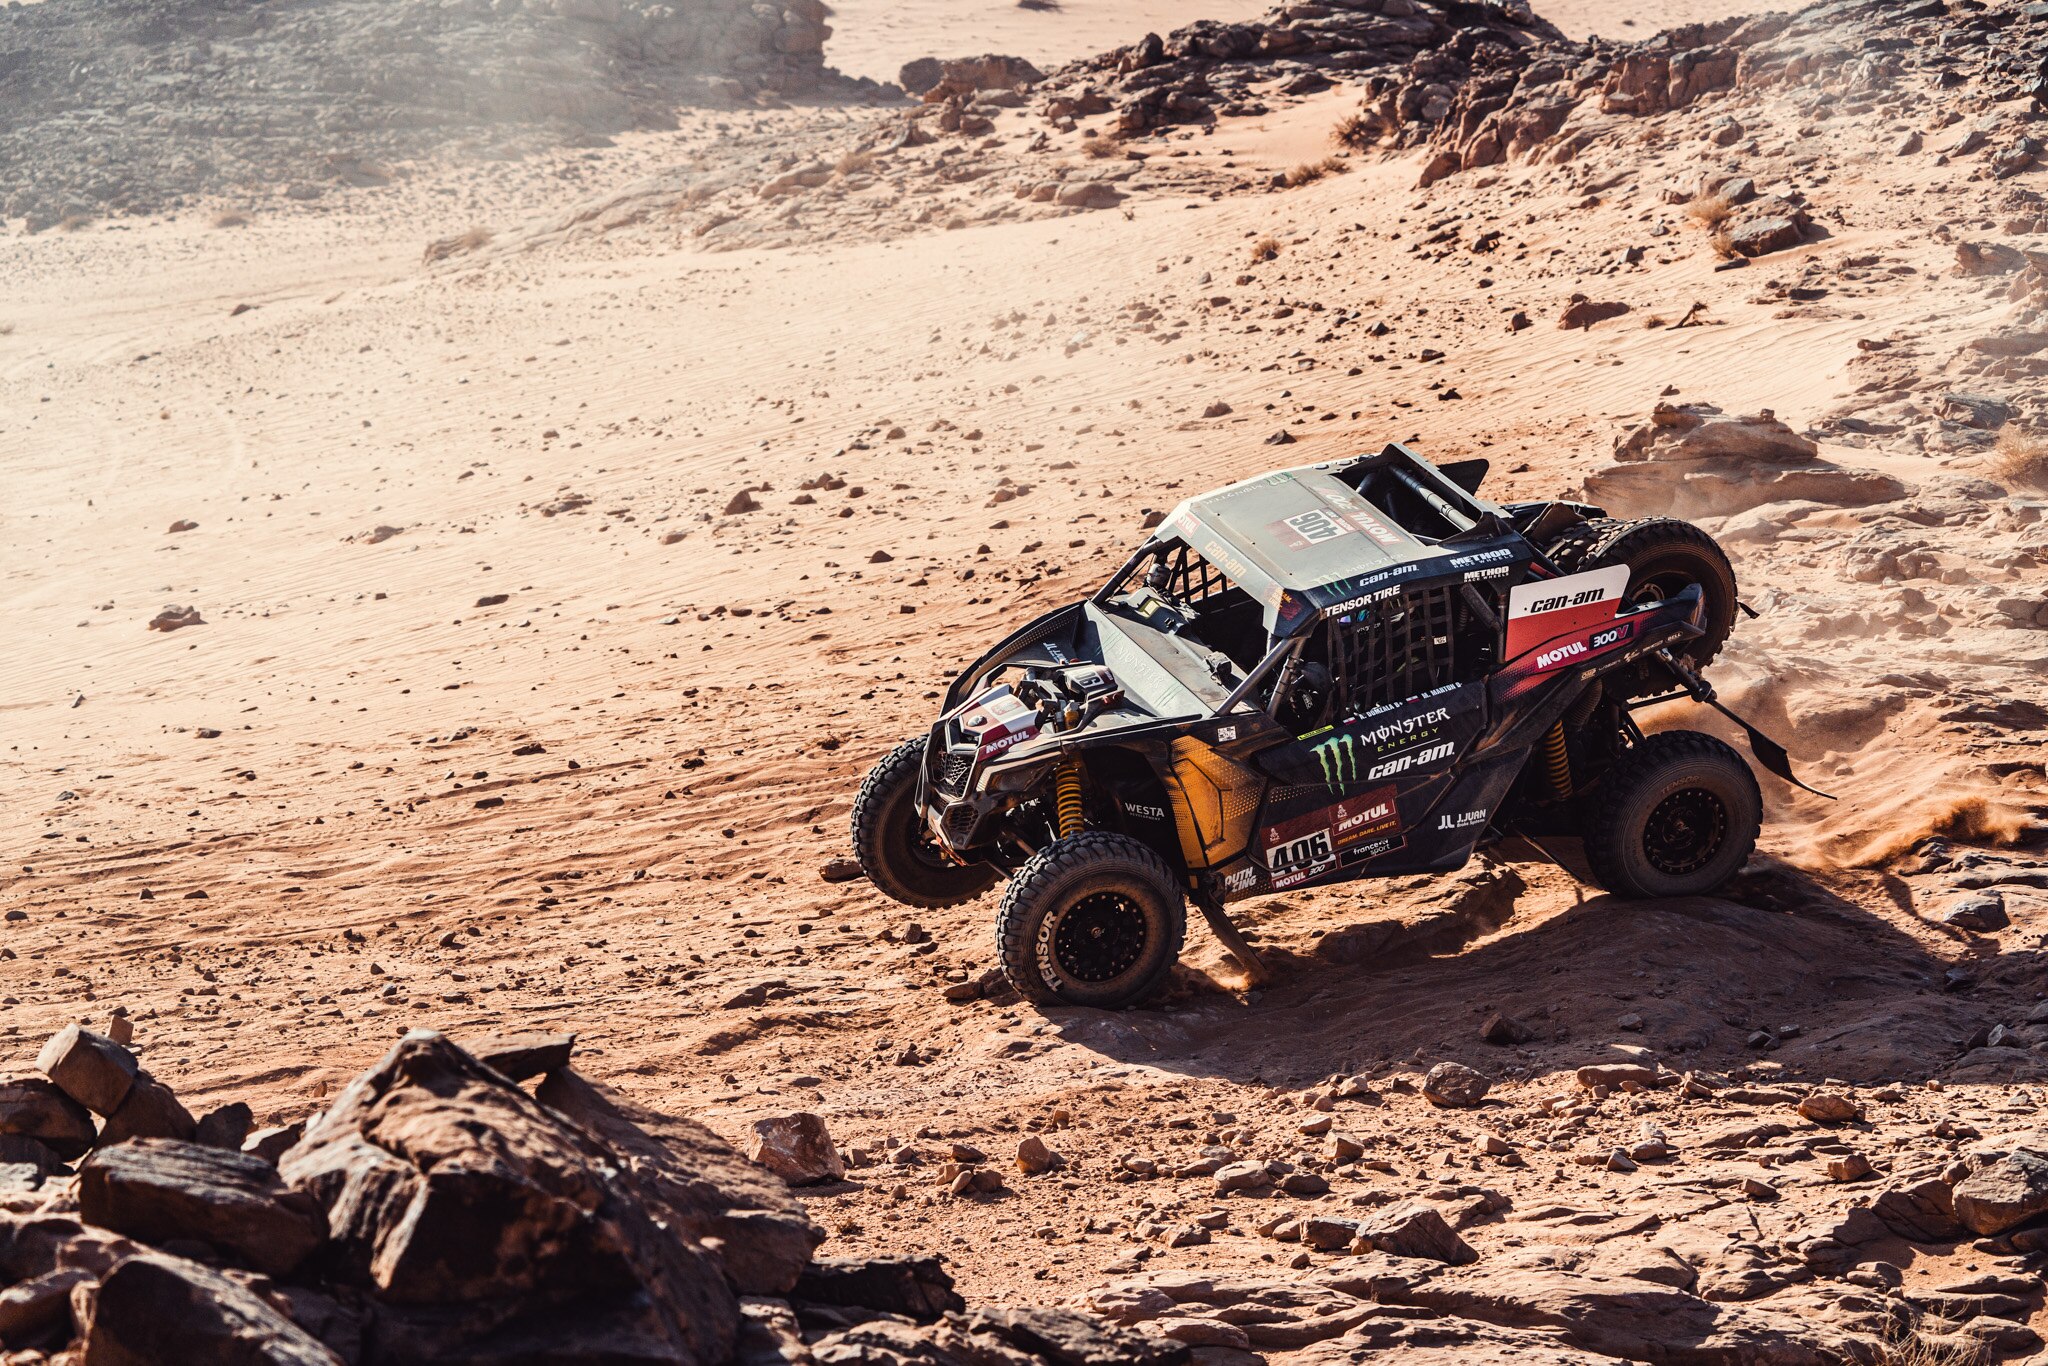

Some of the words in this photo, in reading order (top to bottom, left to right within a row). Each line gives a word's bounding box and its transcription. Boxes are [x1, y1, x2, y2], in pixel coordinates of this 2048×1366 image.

[1289, 511, 1338, 540] 406
[1350, 511, 1399, 542] MOTUL
[1204, 540, 1247, 579] can-am
[1449, 548, 1511, 566] METHOD
[1479, 553, 1514, 564] WHEELS
[1359, 564, 1418, 587] can-am
[1464, 565, 1510, 580] METHOD
[1483, 572, 1509, 580] WHEELS
[1325, 594, 1371, 618] TENSOR
[1373, 584, 1401, 604] TIRE
[1530, 588, 1605, 614] can-am
[1537, 641, 1588, 669] MOTUL
[1593, 624, 1630, 648] 300V
[985, 730, 1030, 754] MOTUL
[1377, 727, 1439, 753] ENERGY
[1368, 741, 1454, 780] can-am
[1124, 802, 1165, 818] WESTA
[1338, 803, 1389, 832] MOTUL
[1376, 822, 1389, 831] LIVE
[1272, 830, 1330, 875] 406
[1275, 872, 1306, 889] MOTUL
[1035, 910, 1064, 993] TENSOR
